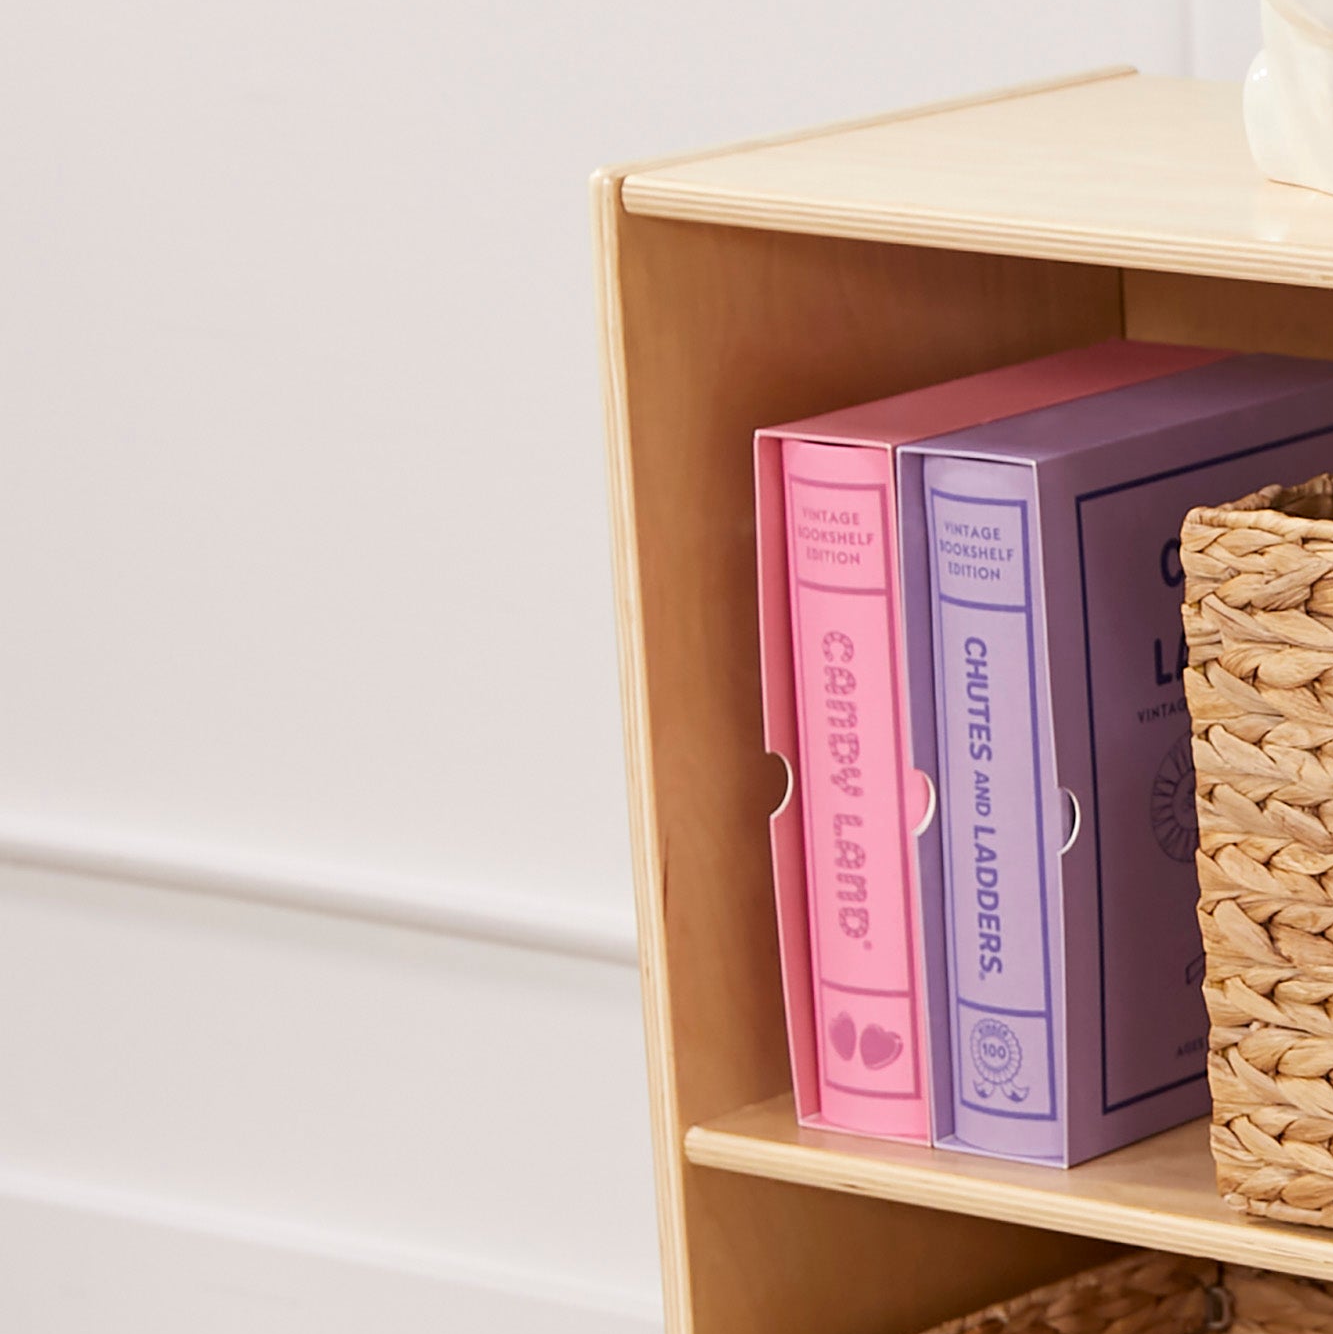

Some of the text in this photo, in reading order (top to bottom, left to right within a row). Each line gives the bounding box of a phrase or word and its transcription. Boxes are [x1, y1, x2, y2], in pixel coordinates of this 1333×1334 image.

[802, 508, 859, 525] VINTAGE
[944, 521, 1001, 541] VINTAGE
[806, 547, 861, 565] EDITION
[948, 561, 1001, 581] EDITION
[1137, 697, 1188, 724] VINTAG
[964, 636, 1003, 975] CHUTES AND LADDERS
[983, 1043, 1006, 1059] 100
